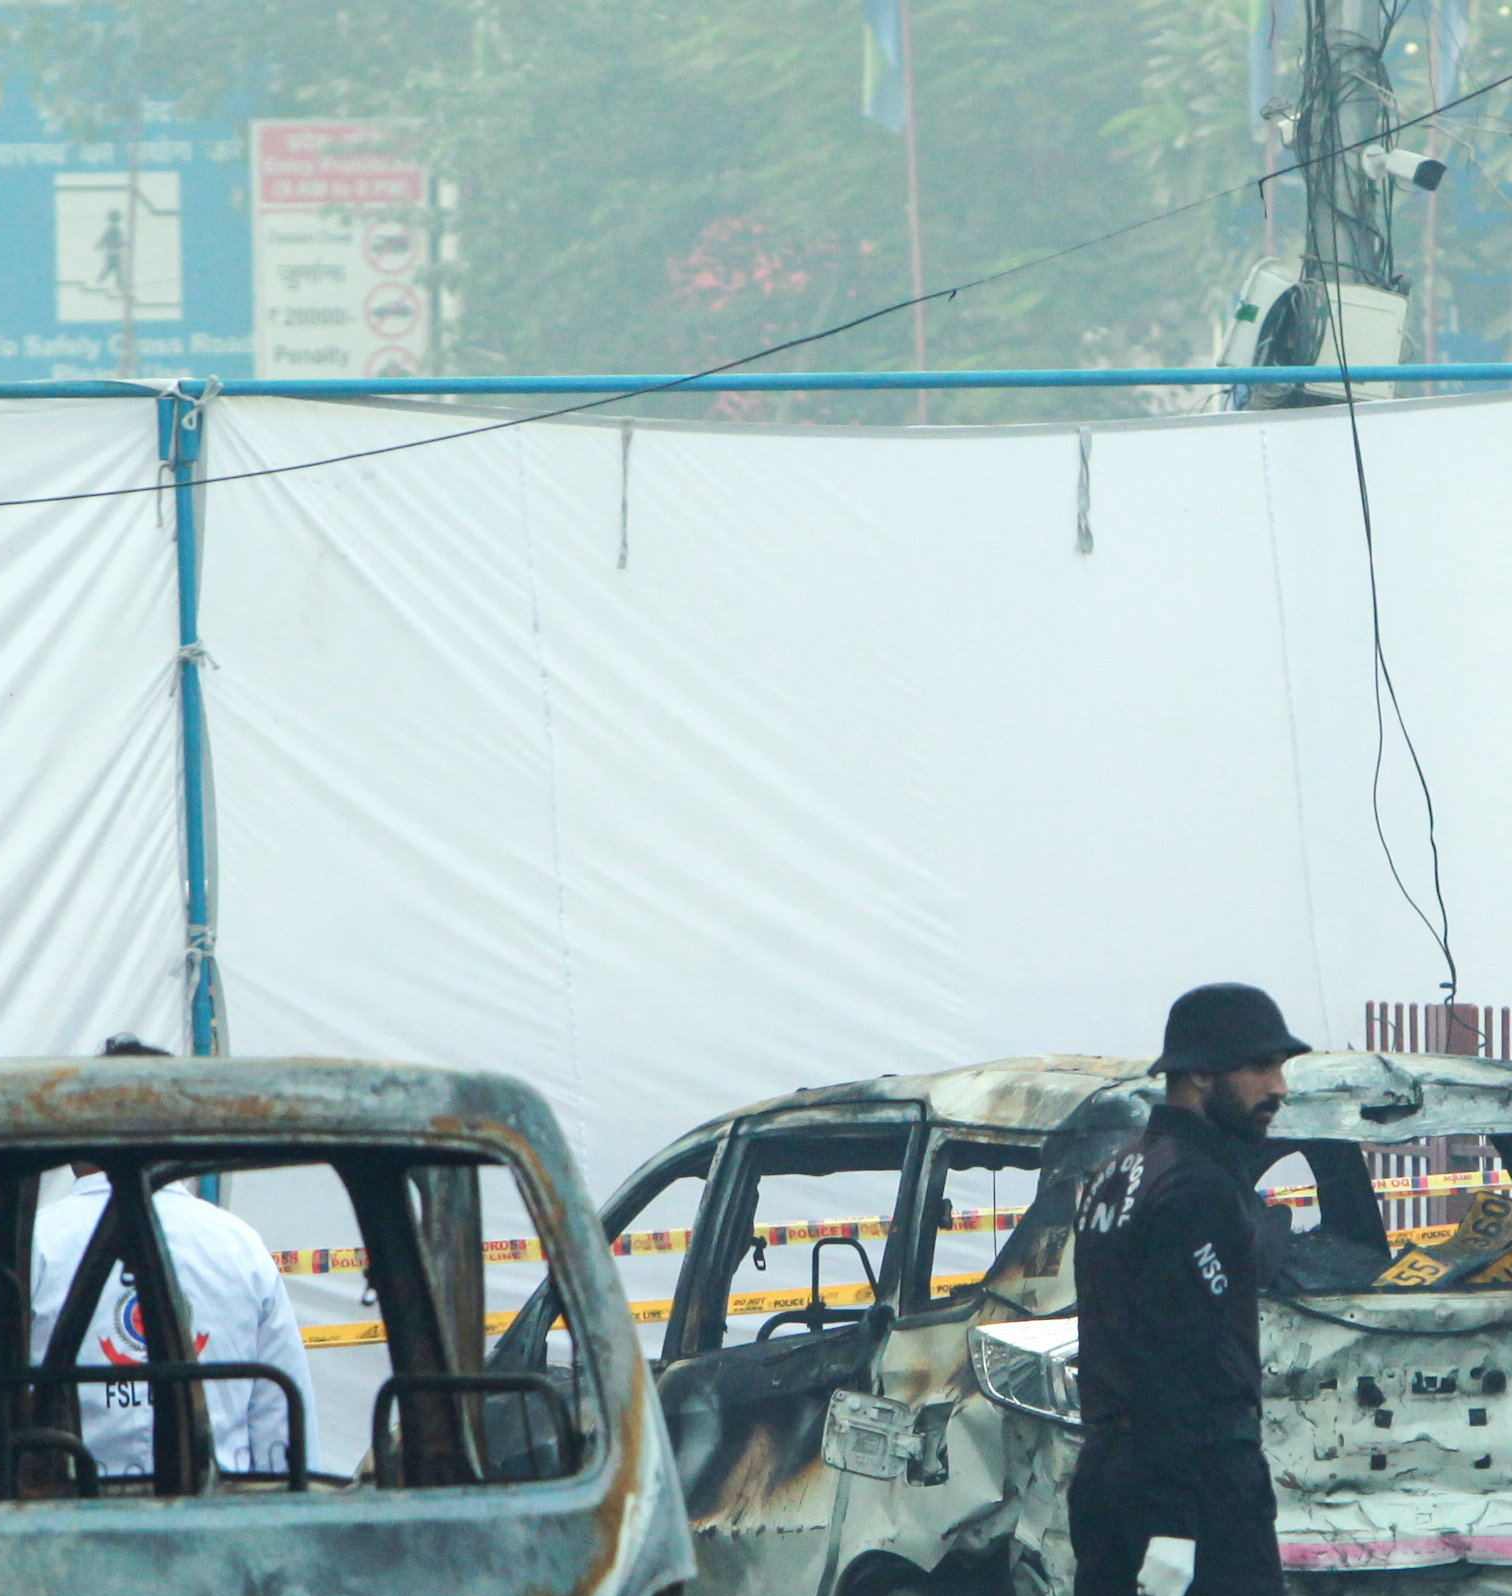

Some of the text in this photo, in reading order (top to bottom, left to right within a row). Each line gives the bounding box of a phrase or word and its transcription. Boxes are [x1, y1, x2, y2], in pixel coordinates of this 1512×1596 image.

[108, 333, 184, 356] Coss
[789, 1226, 839, 1240] POLICE
[1193, 1242, 1228, 1296] NSG
[773, 1299, 804, 1309] POLICE
[106, 1380, 141, 1409] FSL
